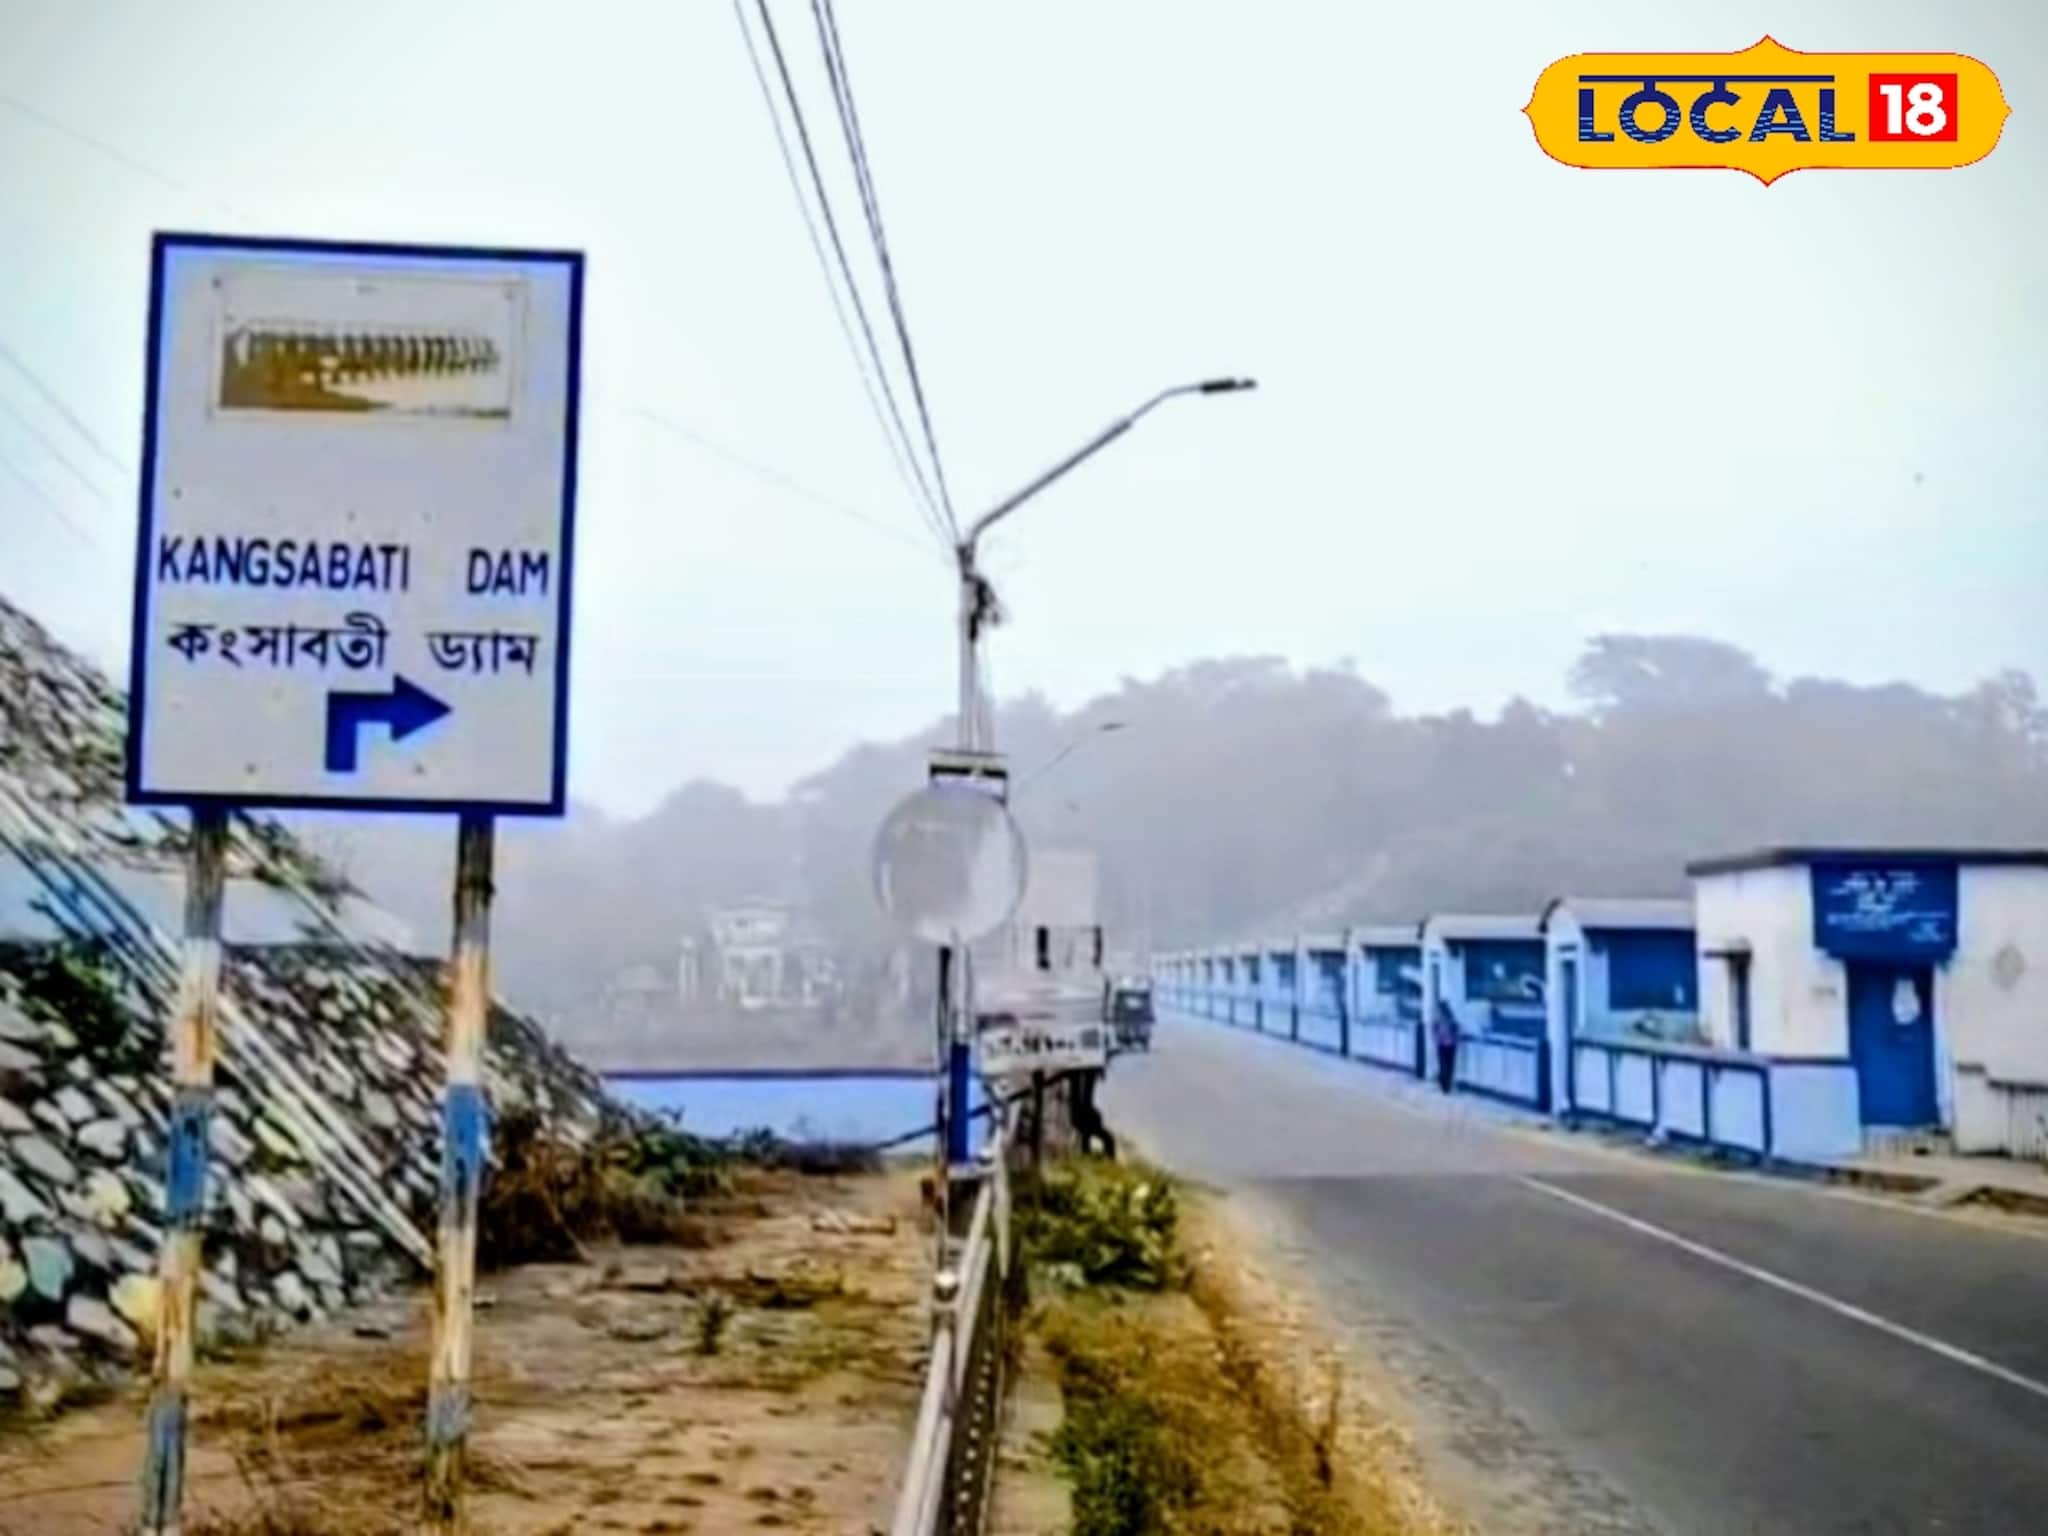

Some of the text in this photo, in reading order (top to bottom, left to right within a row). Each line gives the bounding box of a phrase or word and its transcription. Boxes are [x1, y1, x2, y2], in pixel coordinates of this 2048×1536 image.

[158, 534, 549, 597] KANGSABATI DAM
[166, 612, 540, 676] কংসাবতী ড্যাম
